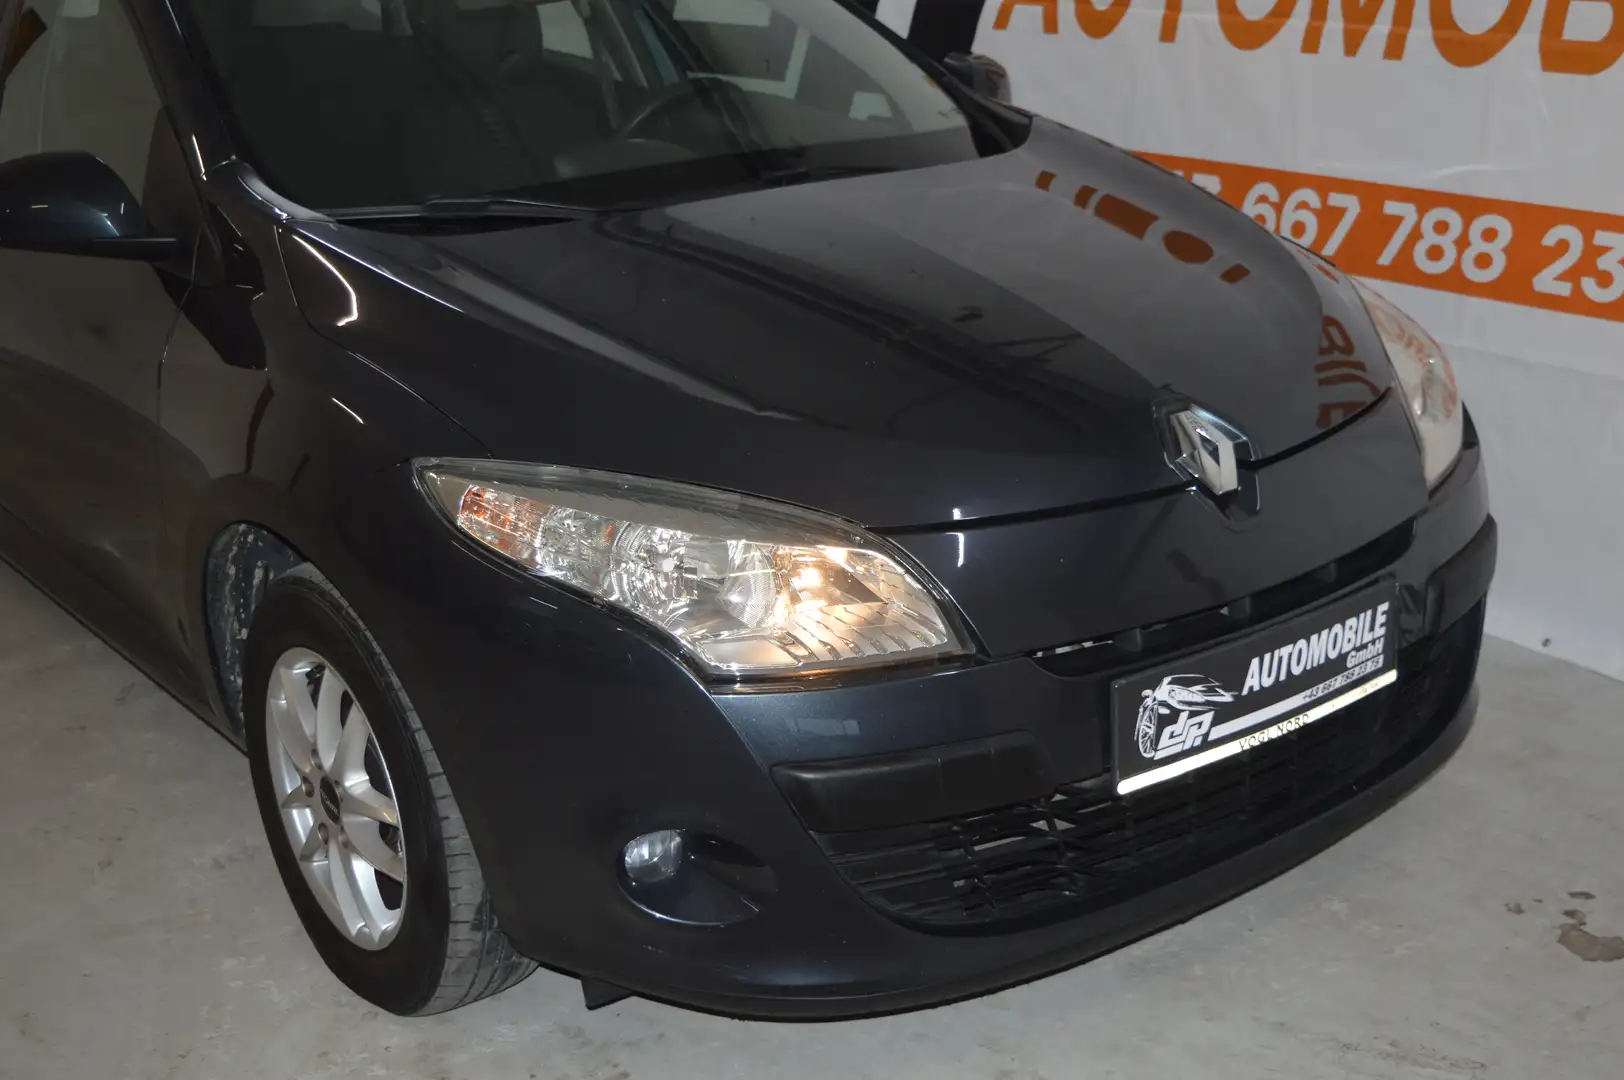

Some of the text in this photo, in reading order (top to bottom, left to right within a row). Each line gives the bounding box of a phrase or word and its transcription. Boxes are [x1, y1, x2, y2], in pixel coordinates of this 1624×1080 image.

[1243, 181, 1624, 304] 667 788 23
[1241, 601, 1390, 696] AUTOMOBILE
[1346, 636, 1385, 669] GmbH
[1239, 713, 1309, 751] VOGL NORD
